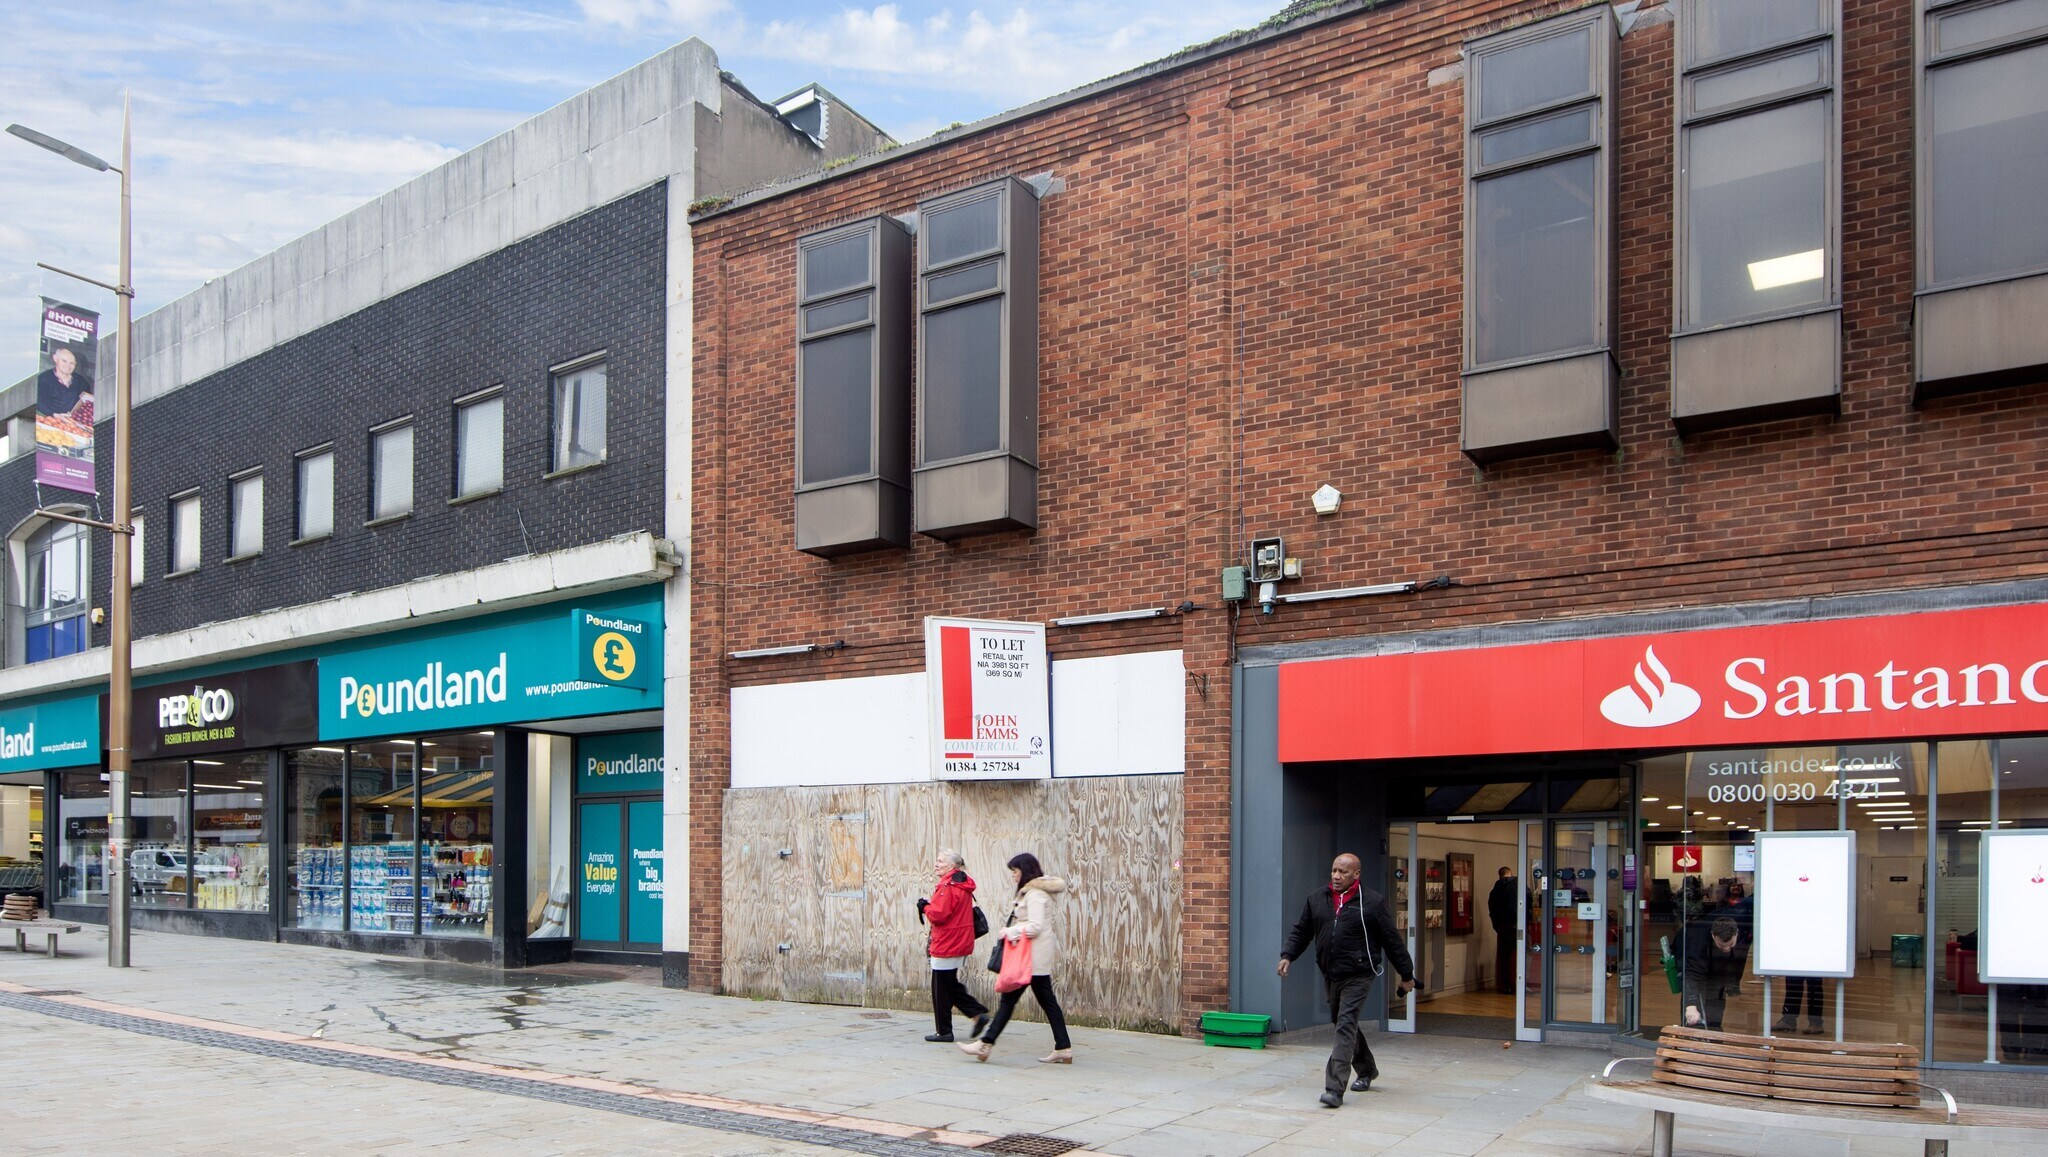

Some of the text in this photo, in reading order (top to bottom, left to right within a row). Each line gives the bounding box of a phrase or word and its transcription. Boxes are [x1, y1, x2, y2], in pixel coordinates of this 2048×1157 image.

[47, 310, 94, 331] #HOME
[586, 614, 642, 634] Poundland
[980, 638, 1025, 651] TO LET
[983, 652, 1006, 660] RETAIL
[1009, 662, 1019, 670] SQ
[1002, 670, 1012, 678] SQ
[340, 652, 506, 719] Poundland
[975, 714, 1017, 728] JOHN
[165, 732, 182, 745] FASHION
[183, 732, 191, 742] FOR
[209, 728, 219, 740] MEN
[220, 728, 224, 739] &
[224, 726, 235, 738] KIDS
[976, 728, 1018, 740] EMMS
[945, 741, 1018, 751] COMMERCIAL
[945, 761, 1020, 772] 01384 257284
[1708, 751, 1903, 776] santander.couk
[1708, 780, 1881, 802] 0800 030 4321
[588, 852, 614, 865] Amazing
[633, 849, 664, 859] Poundlan
[585, 863, 617, 881] Value
[645, 867, 658, 881] big
[586, 881, 615, 895] Everyday!
